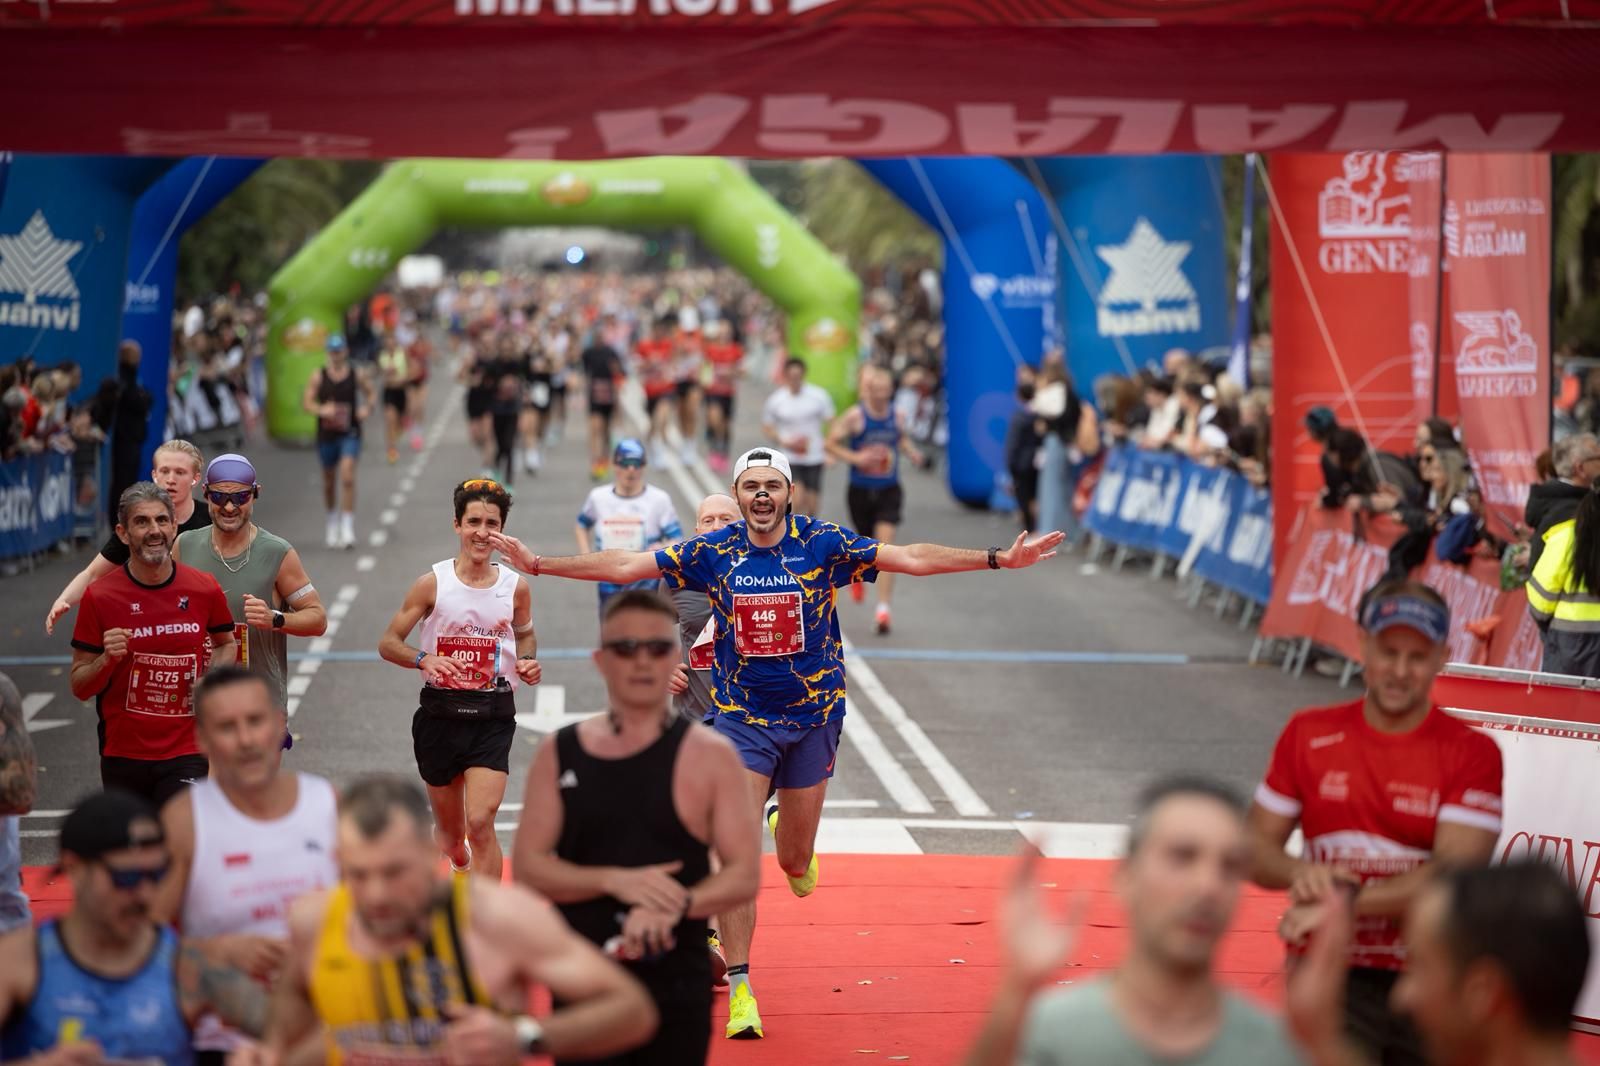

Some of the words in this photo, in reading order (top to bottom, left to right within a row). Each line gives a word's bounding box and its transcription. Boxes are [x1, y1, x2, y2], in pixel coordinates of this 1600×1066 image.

[735, 575, 797, 587] ROMANIA
[748, 595, 790, 605] GENERALI
[751, 610, 777, 622] 446
[156, 623, 200, 636] PEDRO
[453, 638, 494, 648] GENERALI
[150, 657, 190, 667] GENERALI
[451, 650, 481, 663] 4001
[148, 669, 180, 683] 1675
